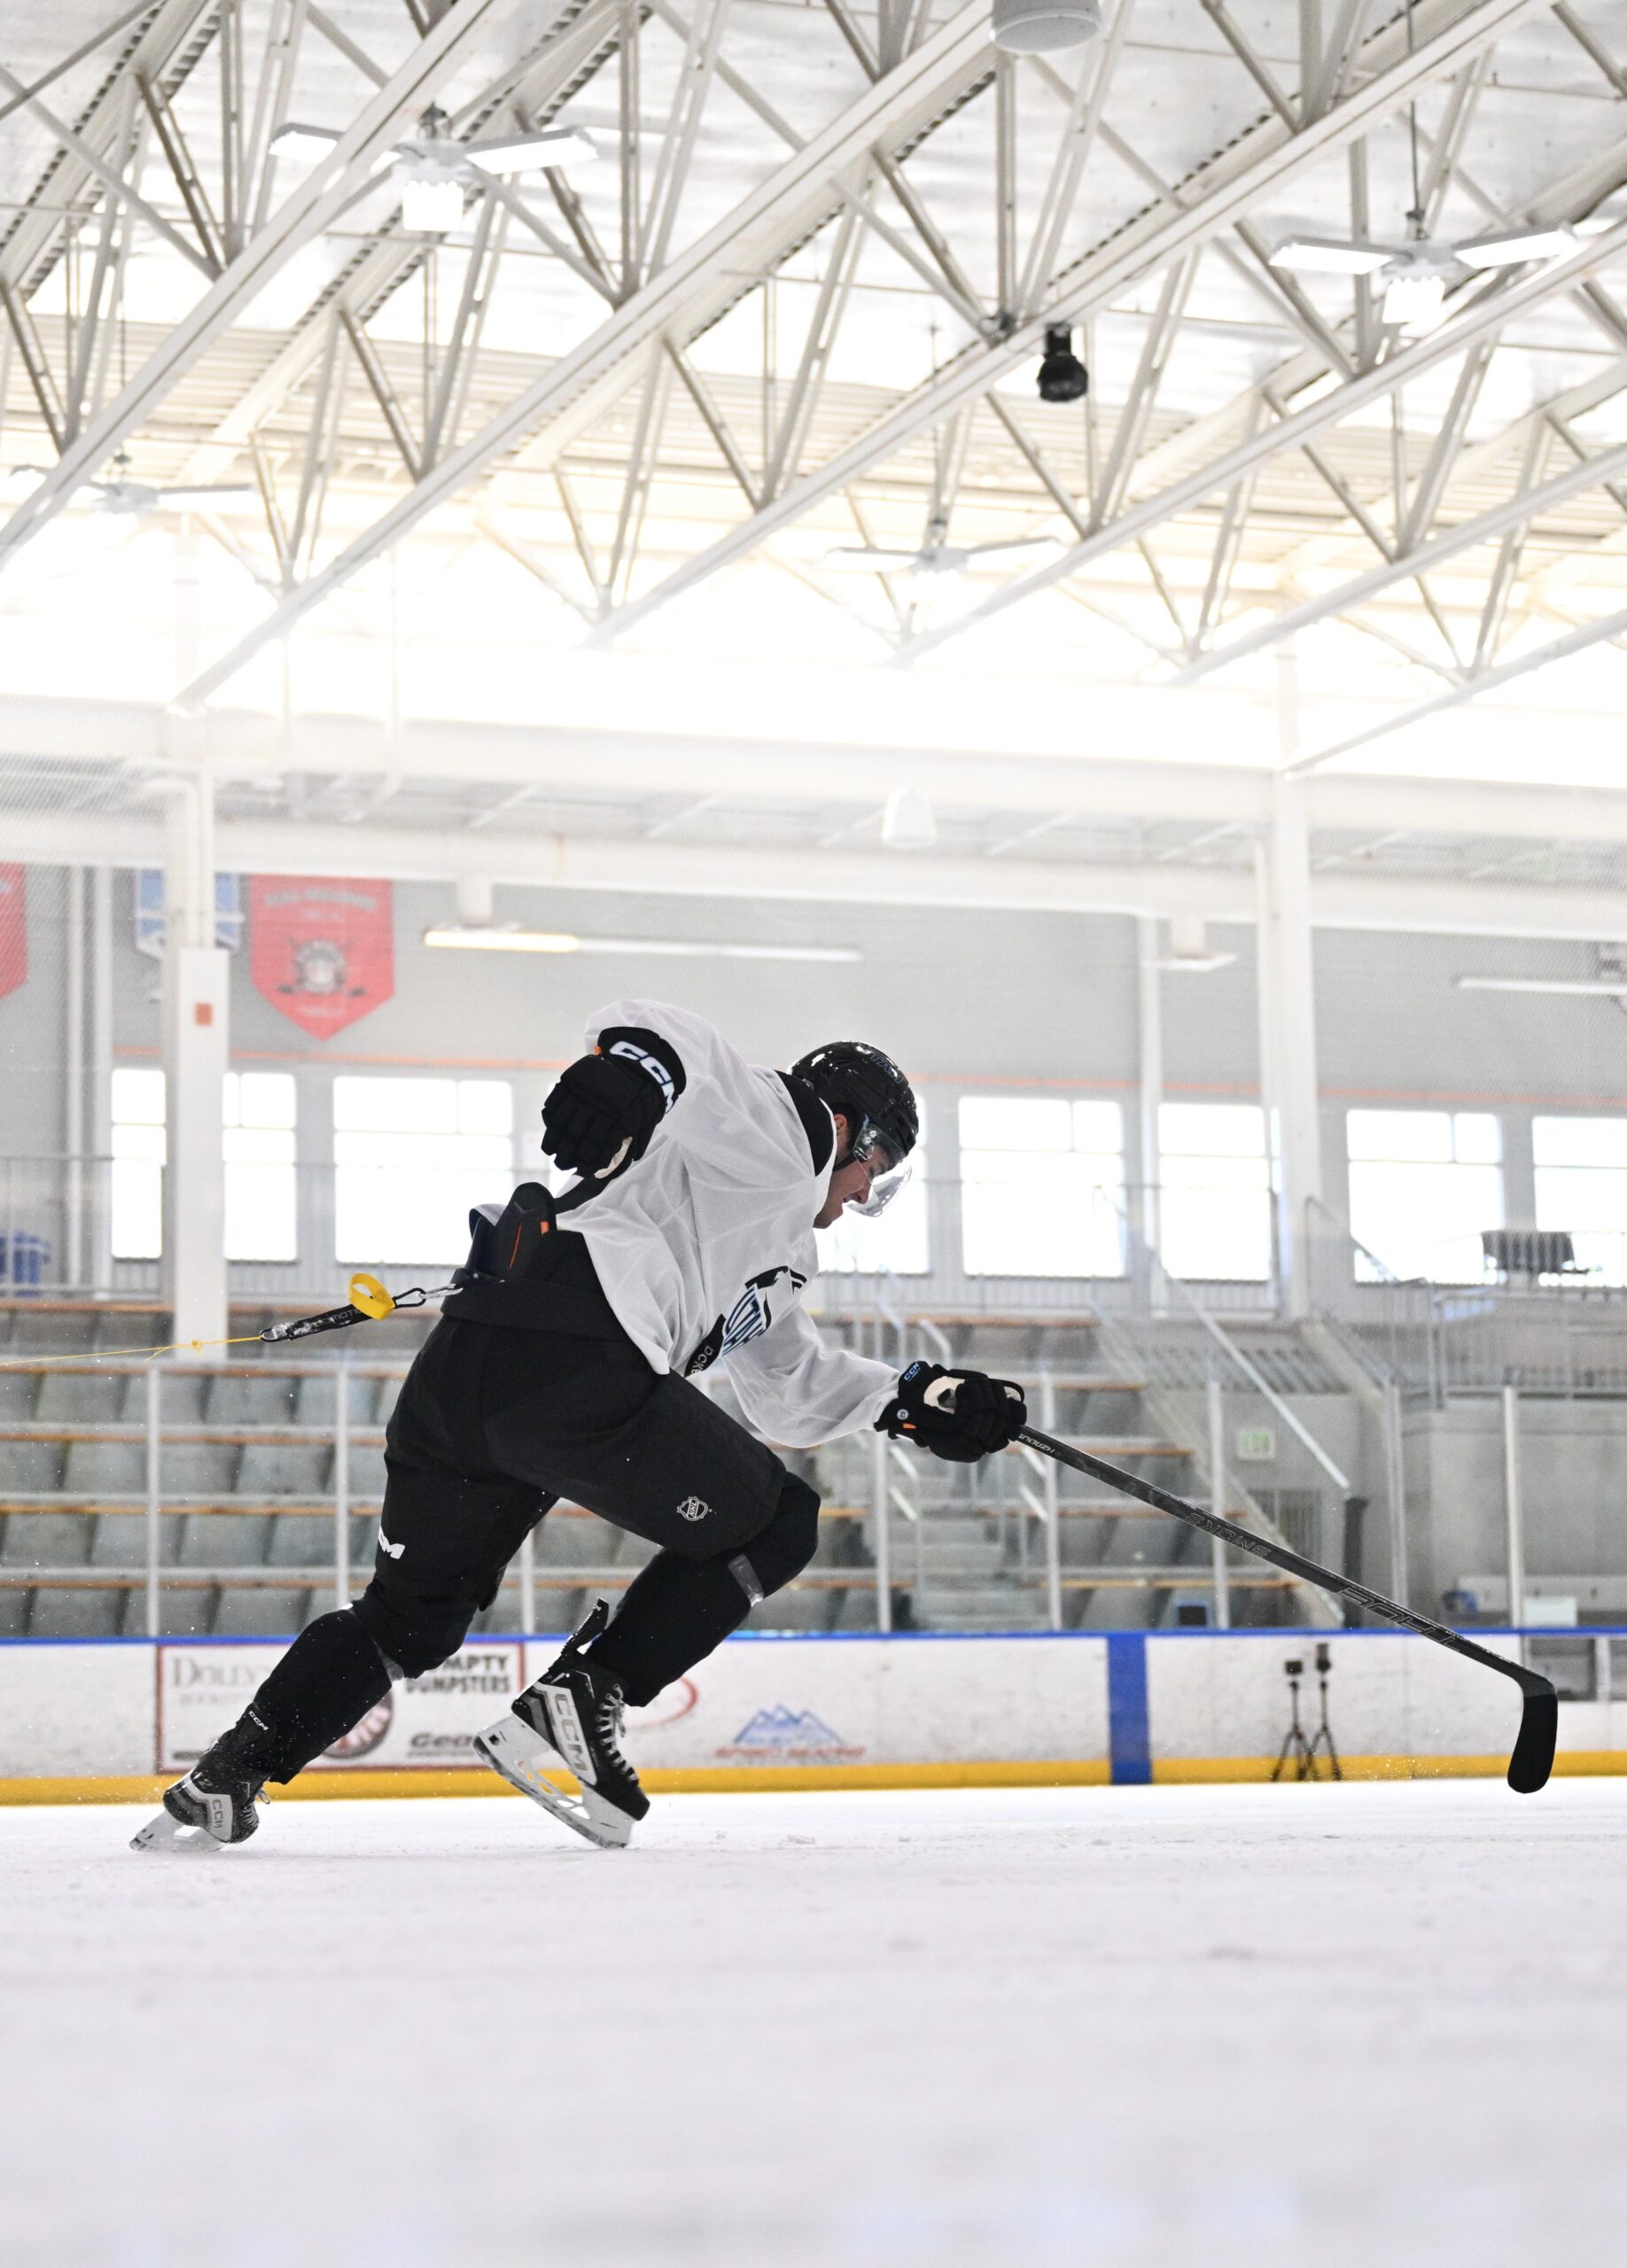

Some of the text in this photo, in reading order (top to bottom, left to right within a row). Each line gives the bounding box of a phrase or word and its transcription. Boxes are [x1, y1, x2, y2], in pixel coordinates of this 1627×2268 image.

[609, 1040, 675, 1114] CCM
[689, 1346, 715, 1374] OCKE
[904, 1363, 921, 1381] CCM
[1184, 1511, 1272, 1559] SMOKE
[1337, 1587, 1460, 1653] TRUE
[442, 1654, 509, 1670] MPTY
[249, 1711, 269, 1731] CCM
[555, 1693, 588, 1771] CCM
[214, 1798, 223, 1828] CCM
